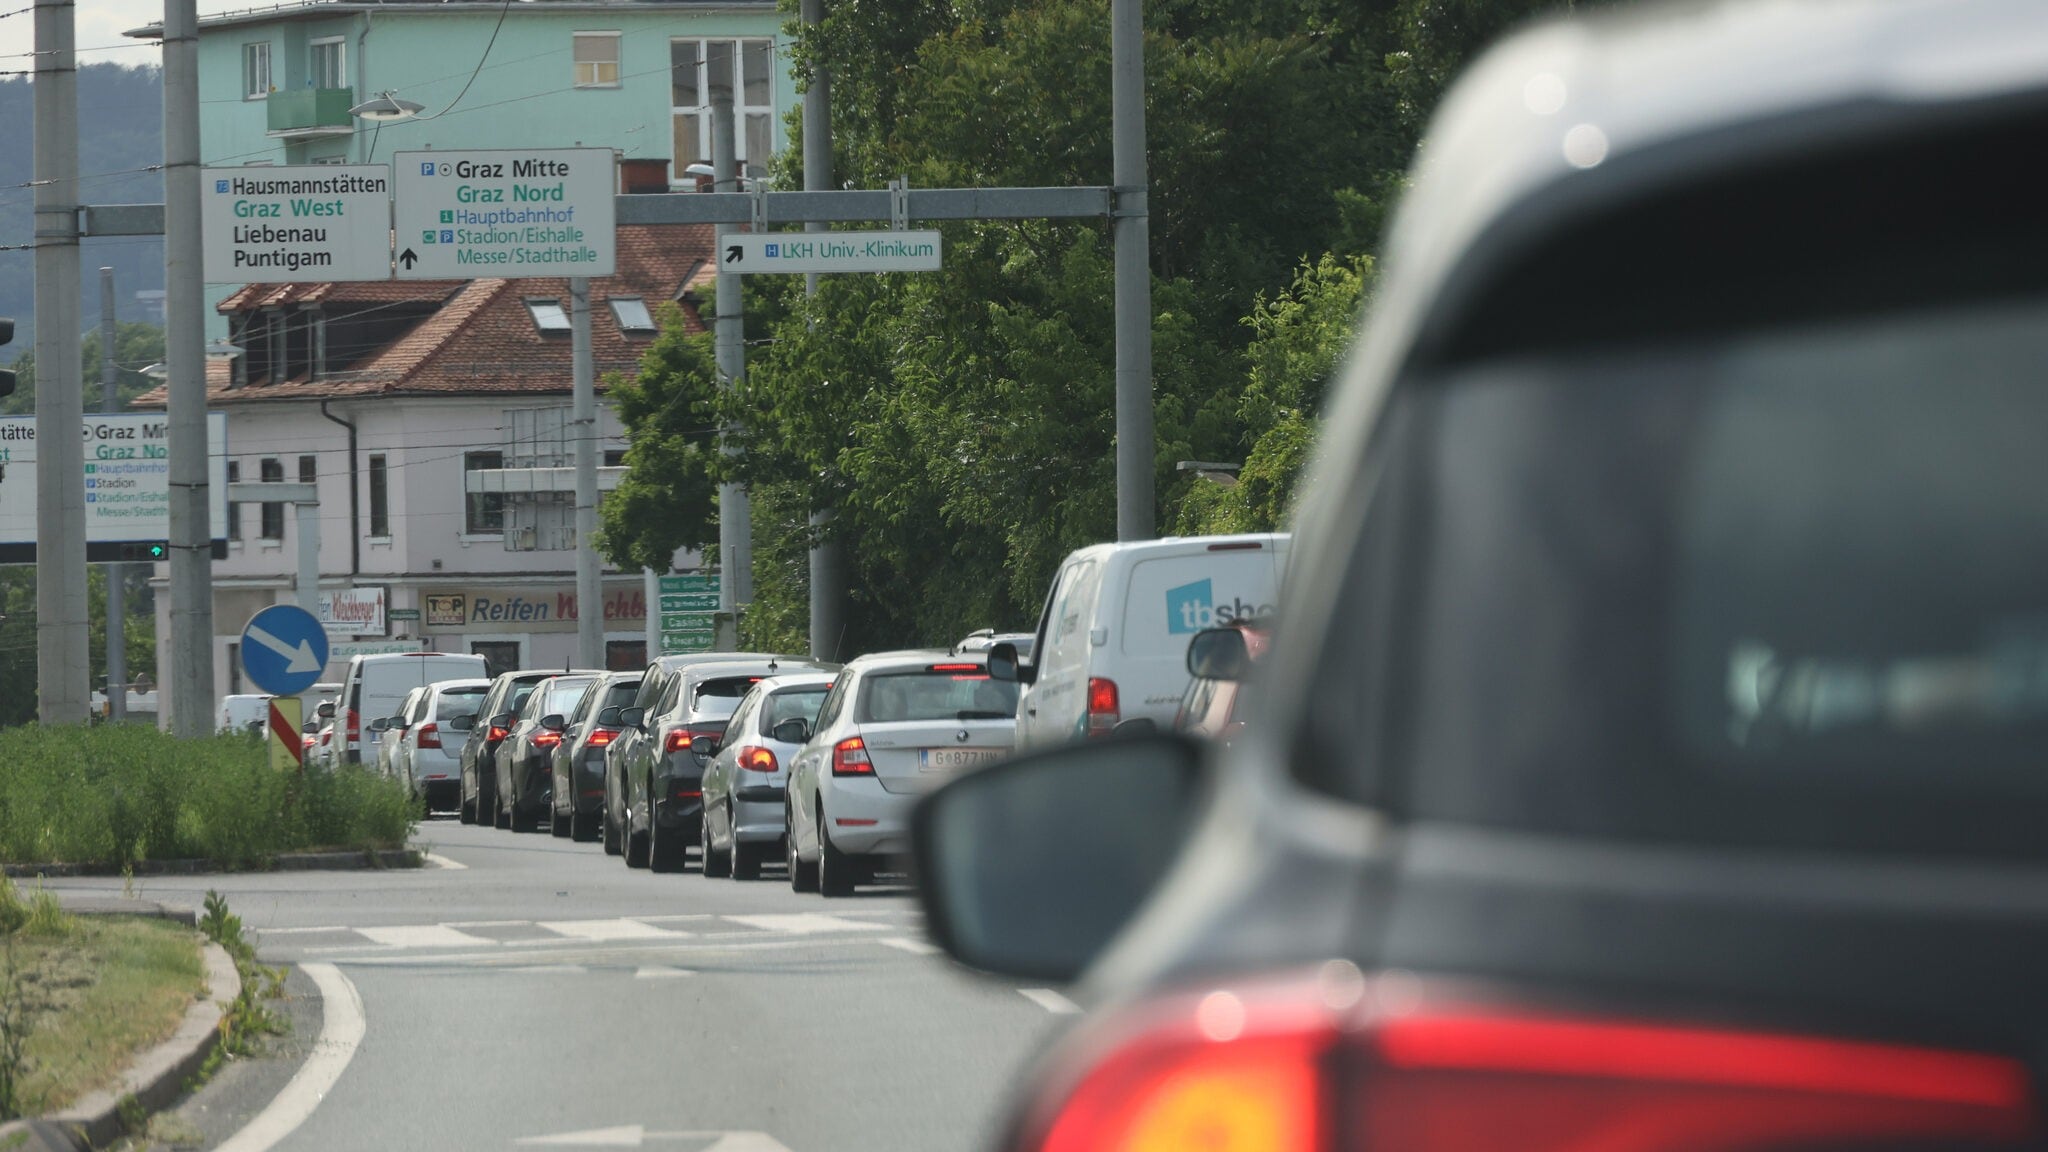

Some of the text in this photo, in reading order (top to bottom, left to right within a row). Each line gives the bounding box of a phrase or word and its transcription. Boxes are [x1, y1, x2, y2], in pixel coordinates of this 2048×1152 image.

[456, 161, 504, 178] Graz
[513, 159, 569, 177] Mitte
[233, 174, 386, 195] Hausmannstätten
[457, 183, 563, 203] Graz Nord
[234, 199, 344, 218] Graz West
[457, 206, 574, 228] Hauptbahnhof
[234, 224, 327, 244] Liebenau
[457, 226, 584, 245] Stadion/Eishalle
[457, 246, 597, 264] Messe/Stadthalle
[782, 243, 813, 258] LKH
[820, 240, 933, 258] Univ.-Klinikum
[234, 248, 332, 271] Puntigam
[96, 425, 135, 440] Graz
[96, 444, 168, 459] Graz No
[96, 463, 168, 476] Hauptbahnho
[96, 477, 136, 488] Stadion
[472, 597, 548, 621] Reifen
